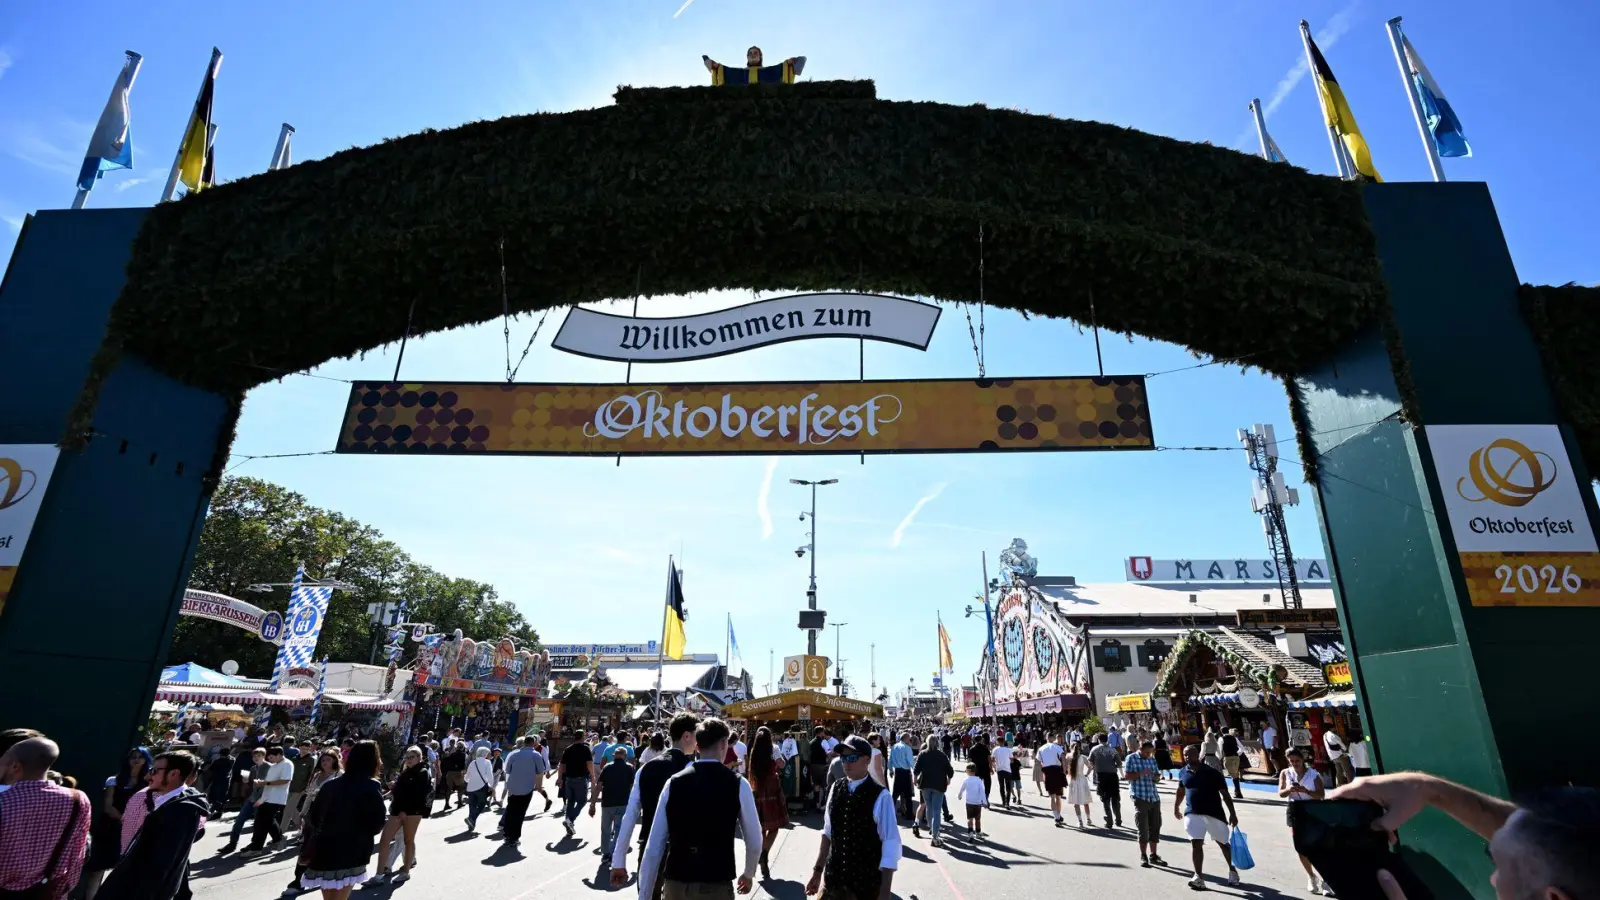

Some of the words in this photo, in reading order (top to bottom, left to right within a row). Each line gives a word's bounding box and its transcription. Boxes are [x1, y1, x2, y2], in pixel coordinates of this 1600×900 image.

[619, 310, 805, 350] Willkommen
[813, 307, 872, 328] zum
[583, 390, 902, 445] Oktoberfest
[1469, 516, 1575, 538] Oktoberfest
[1495, 564, 1582, 594] 2026
[183, 600, 260, 628] BIERKARUSSELL
[264, 625, 277, 638] HB
[480, 654, 495, 668] ALL
[502, 658, 522, 674] STARS
[1328, 664, 1349, 676] And
[742, 698, 782, 712] Souvenirs
[824, 696, 872, 712] Information
